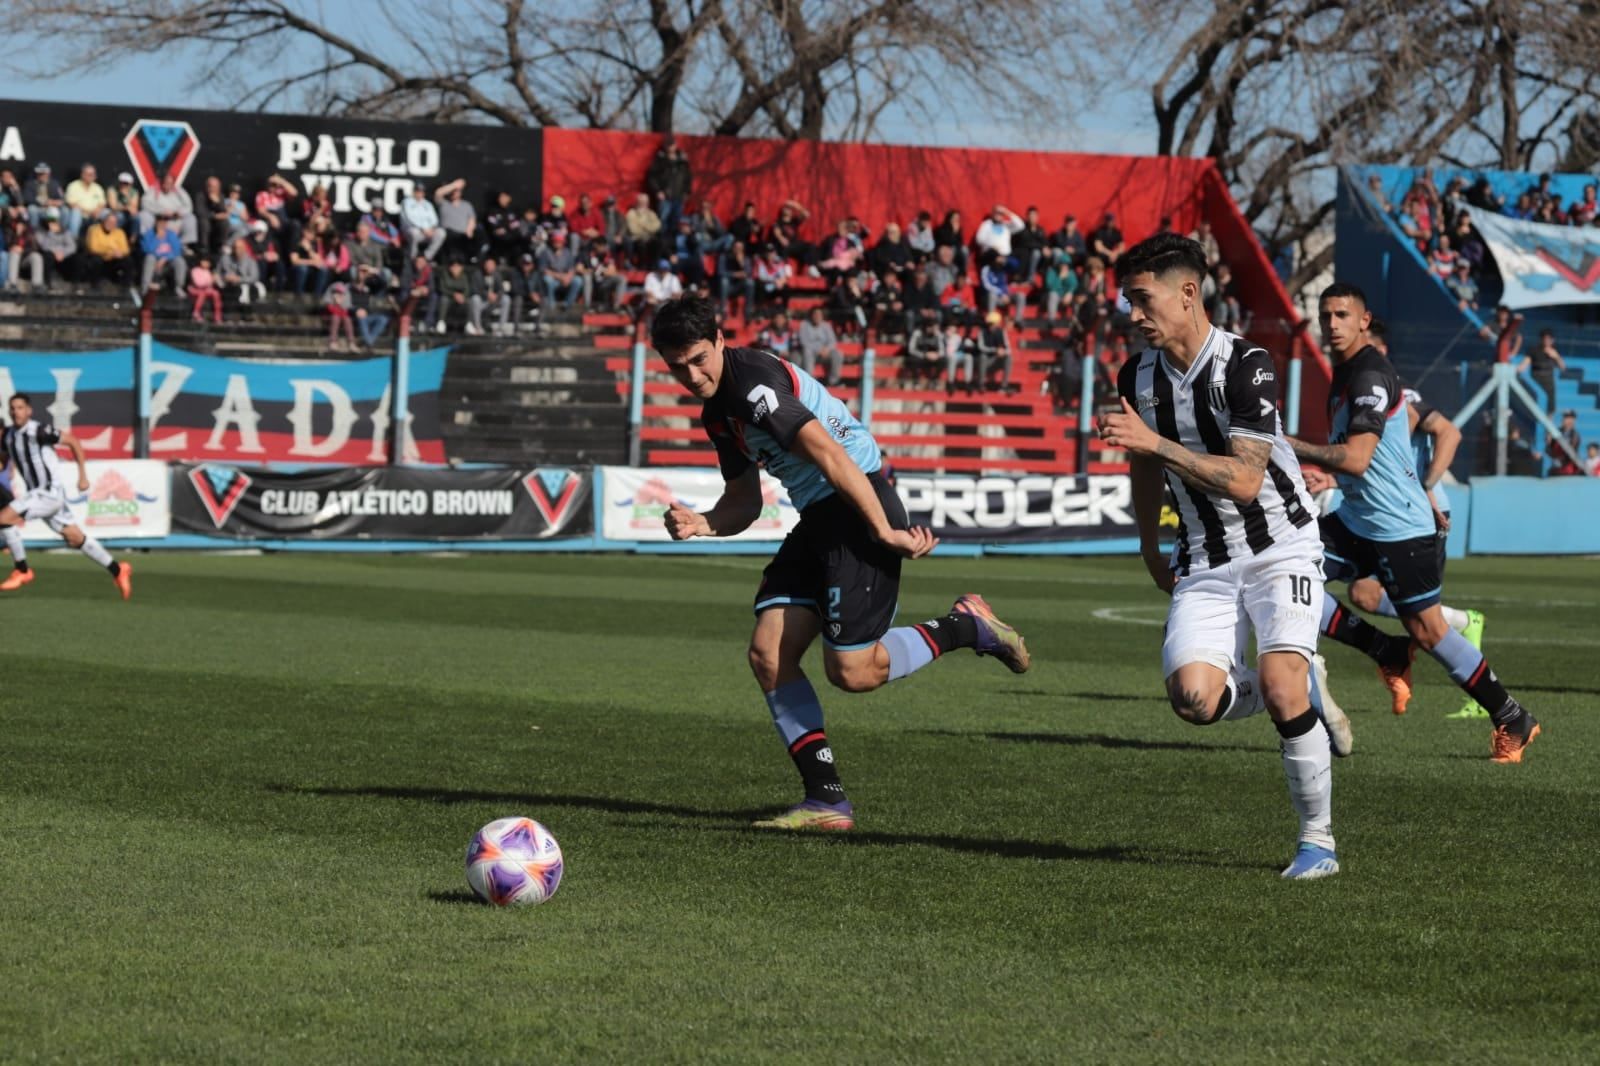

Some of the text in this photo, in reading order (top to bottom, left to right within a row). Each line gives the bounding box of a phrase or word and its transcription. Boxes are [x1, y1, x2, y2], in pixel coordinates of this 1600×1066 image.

[277, 132, 441, 177] PABLO
[260, 485, 513, 516] CLUB ATLÉTICO BROWN
[896, 475, 1135, 528] PROCER
[828, 586, 841, 619] 2
[1289, 574, 1312, 607] 10
